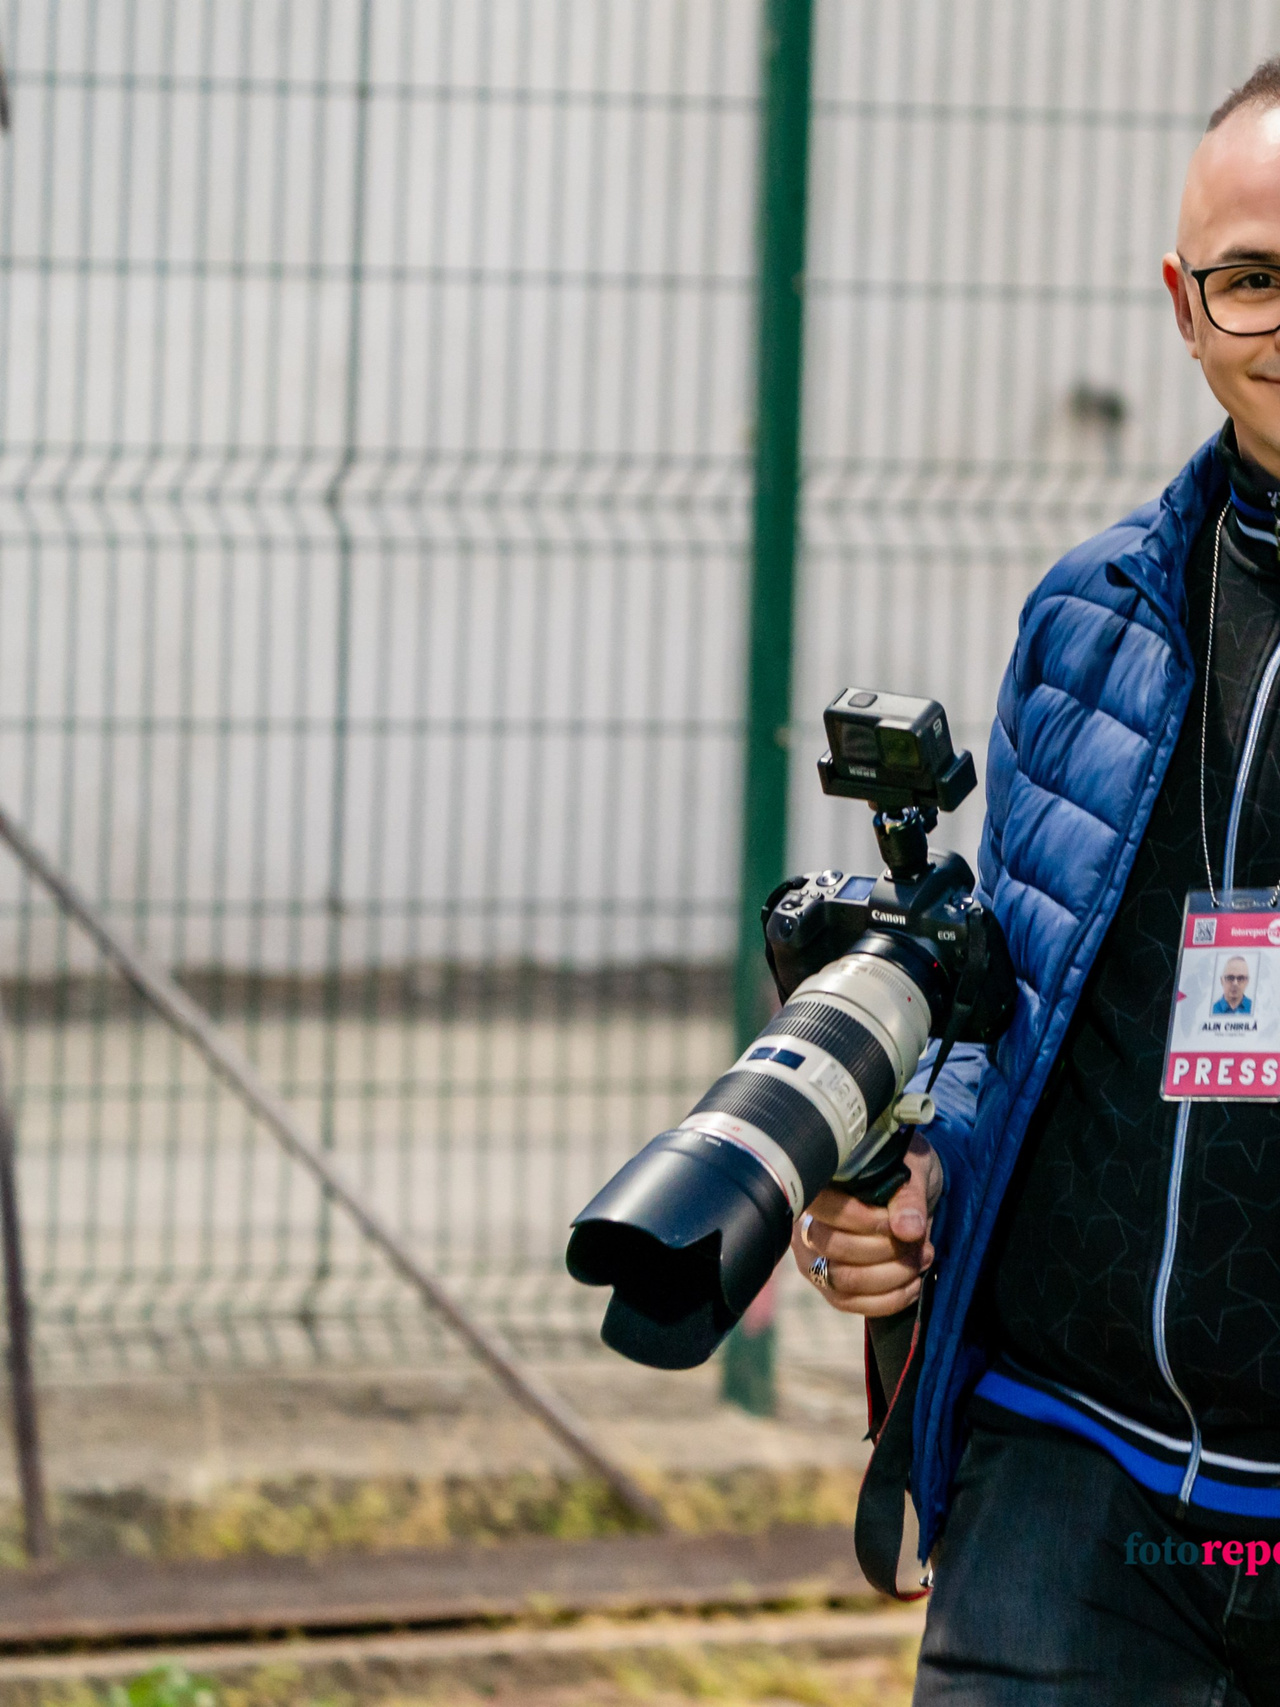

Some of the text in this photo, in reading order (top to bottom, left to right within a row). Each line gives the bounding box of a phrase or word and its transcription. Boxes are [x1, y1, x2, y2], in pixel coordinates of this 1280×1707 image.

[871, 909, 906, 926] Canon
[938, 930, 956, 941] EOS
[1202, 1021, 1221, 1032] ALIN
[1173, 1058, 1279, 1085] PRESS
